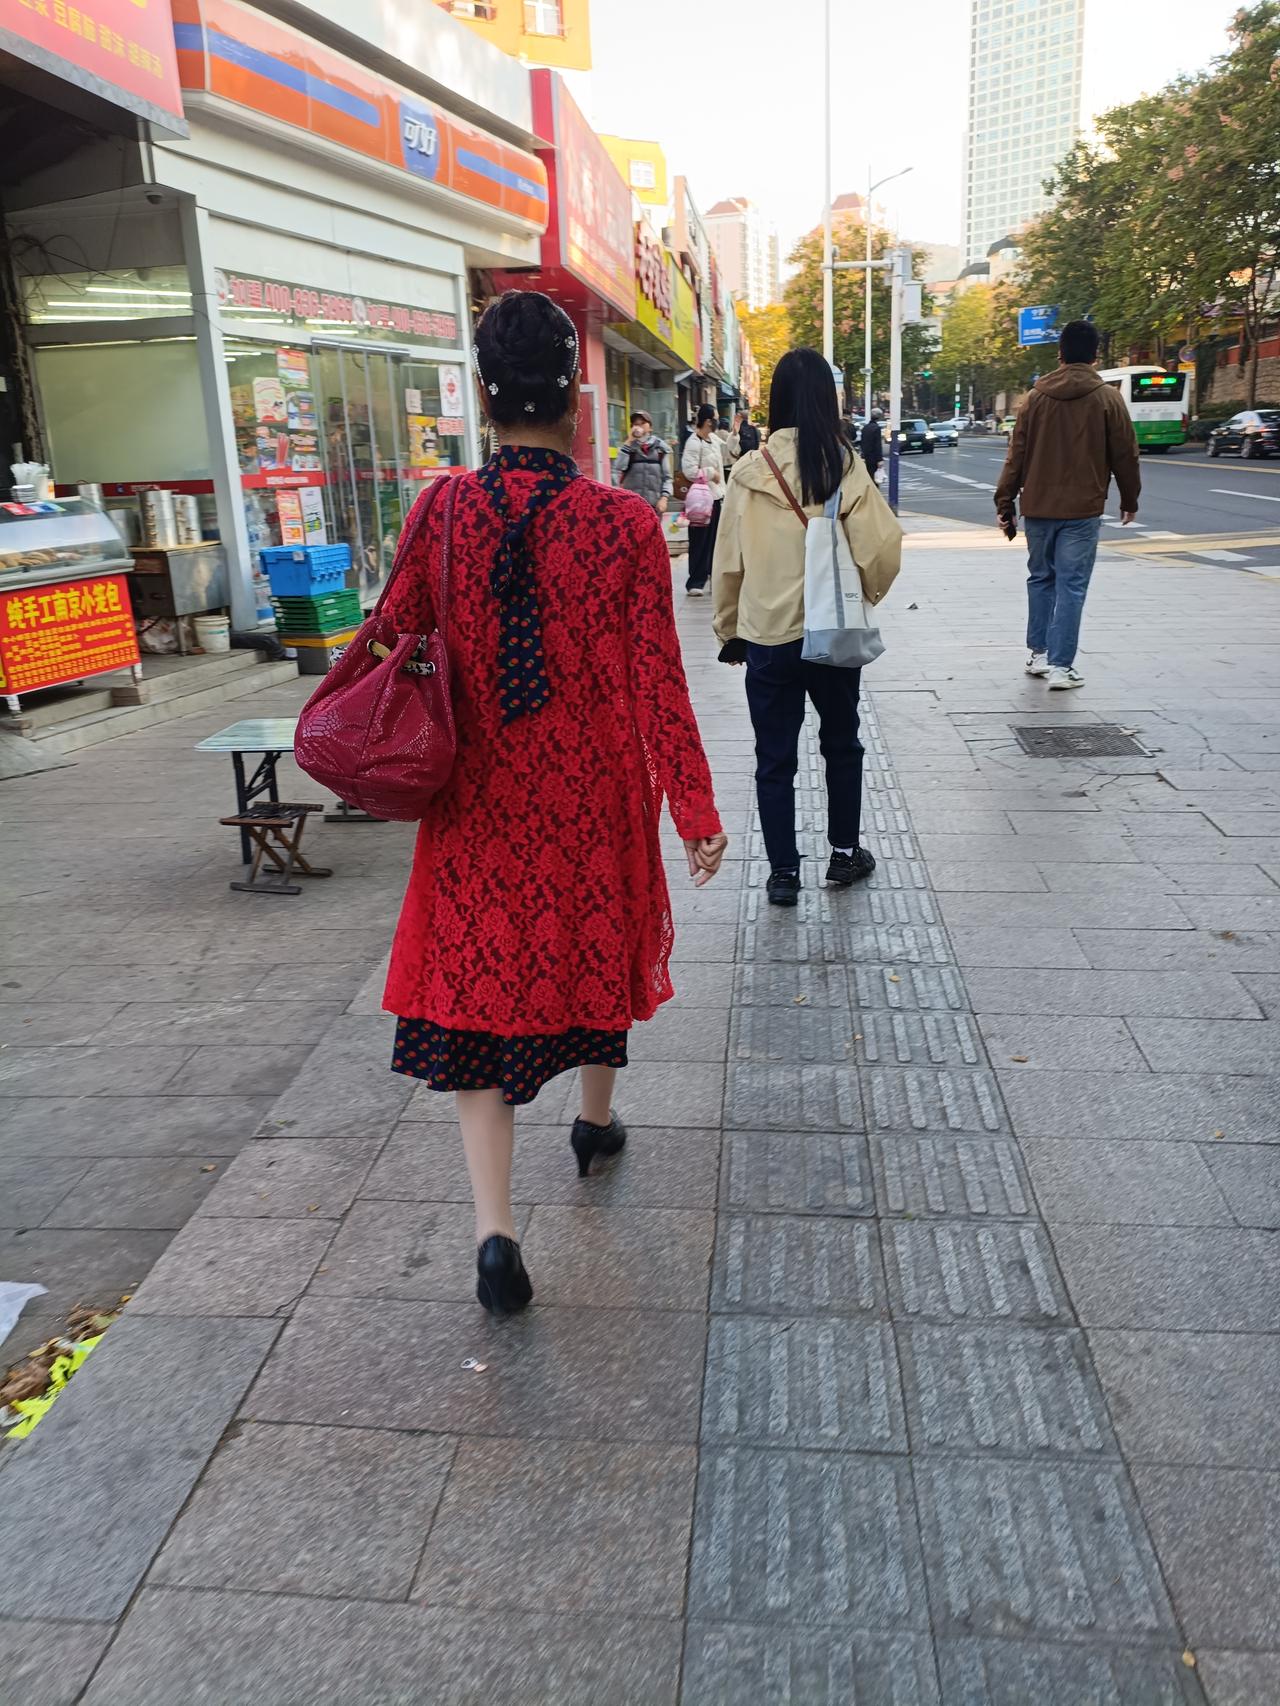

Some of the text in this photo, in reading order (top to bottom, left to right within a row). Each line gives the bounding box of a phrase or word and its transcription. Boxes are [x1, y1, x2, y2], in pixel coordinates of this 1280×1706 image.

[6, 581, 122, 630] 纯手工南京小笼包
